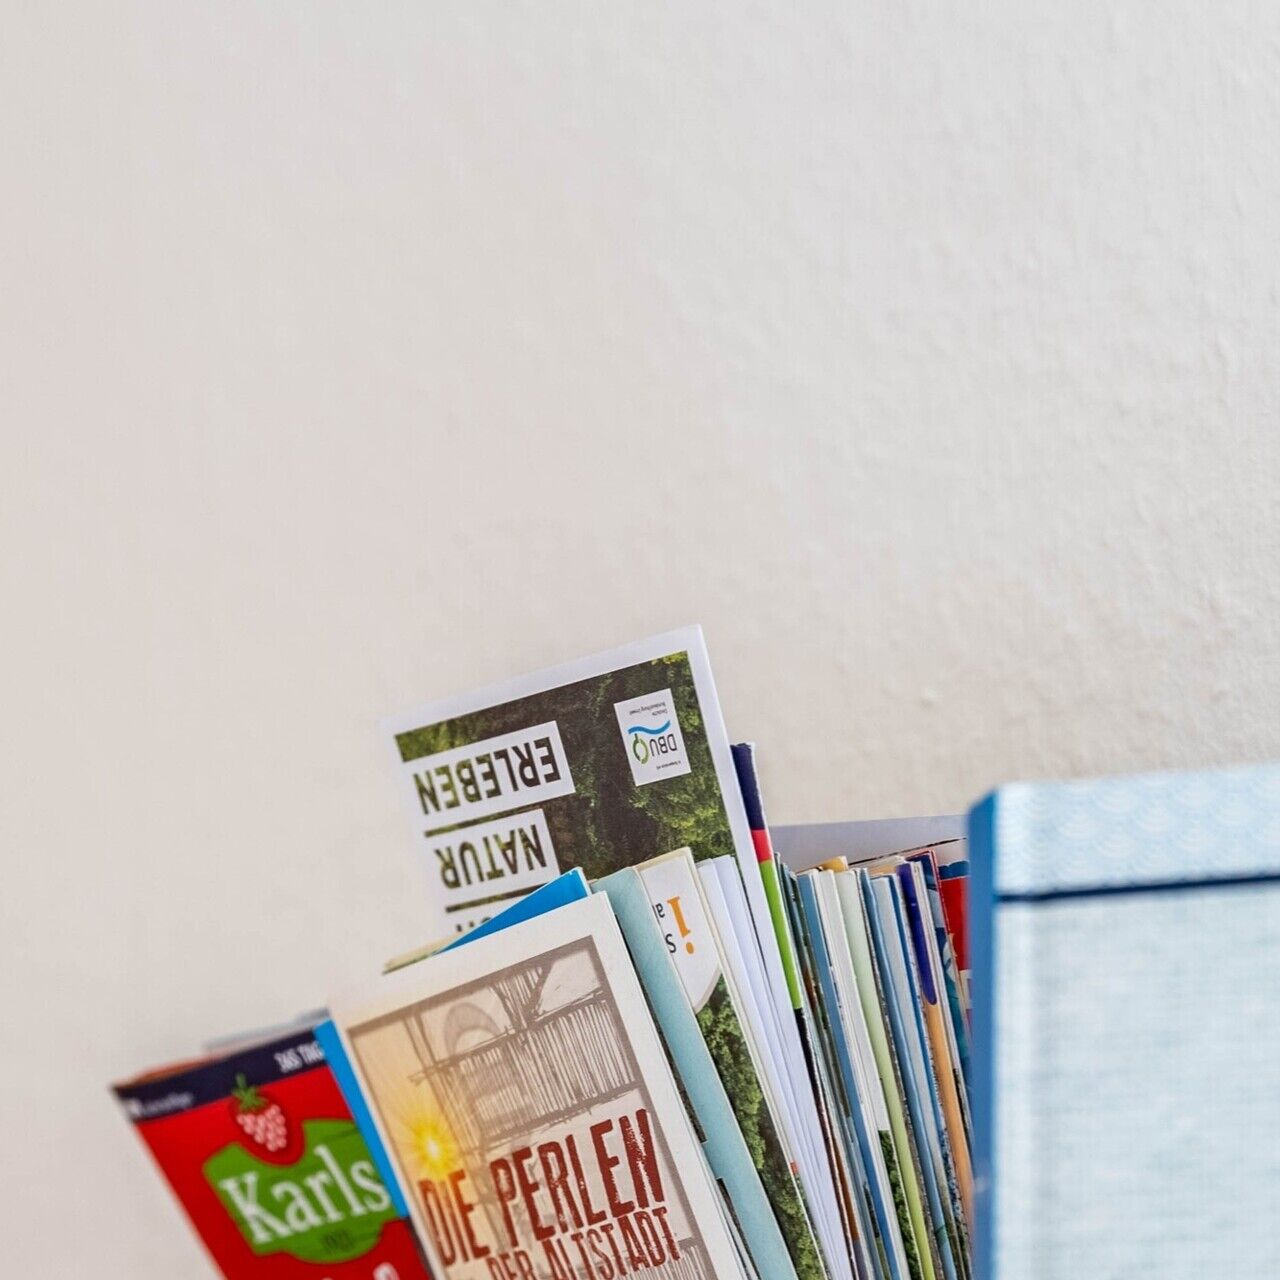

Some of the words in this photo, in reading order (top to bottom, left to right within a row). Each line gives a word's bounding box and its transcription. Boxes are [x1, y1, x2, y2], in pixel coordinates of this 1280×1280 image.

[413, 736, 561, 815] ERLEBEN
[649, 733, 678, 757] DBU
[434, 824, 548, 890] NATUR
[218, 1144, 392, 1245] Karls
[417, 1169, 491, 1267] DIE
[489, 1108, 665, 1248] PERLEN
